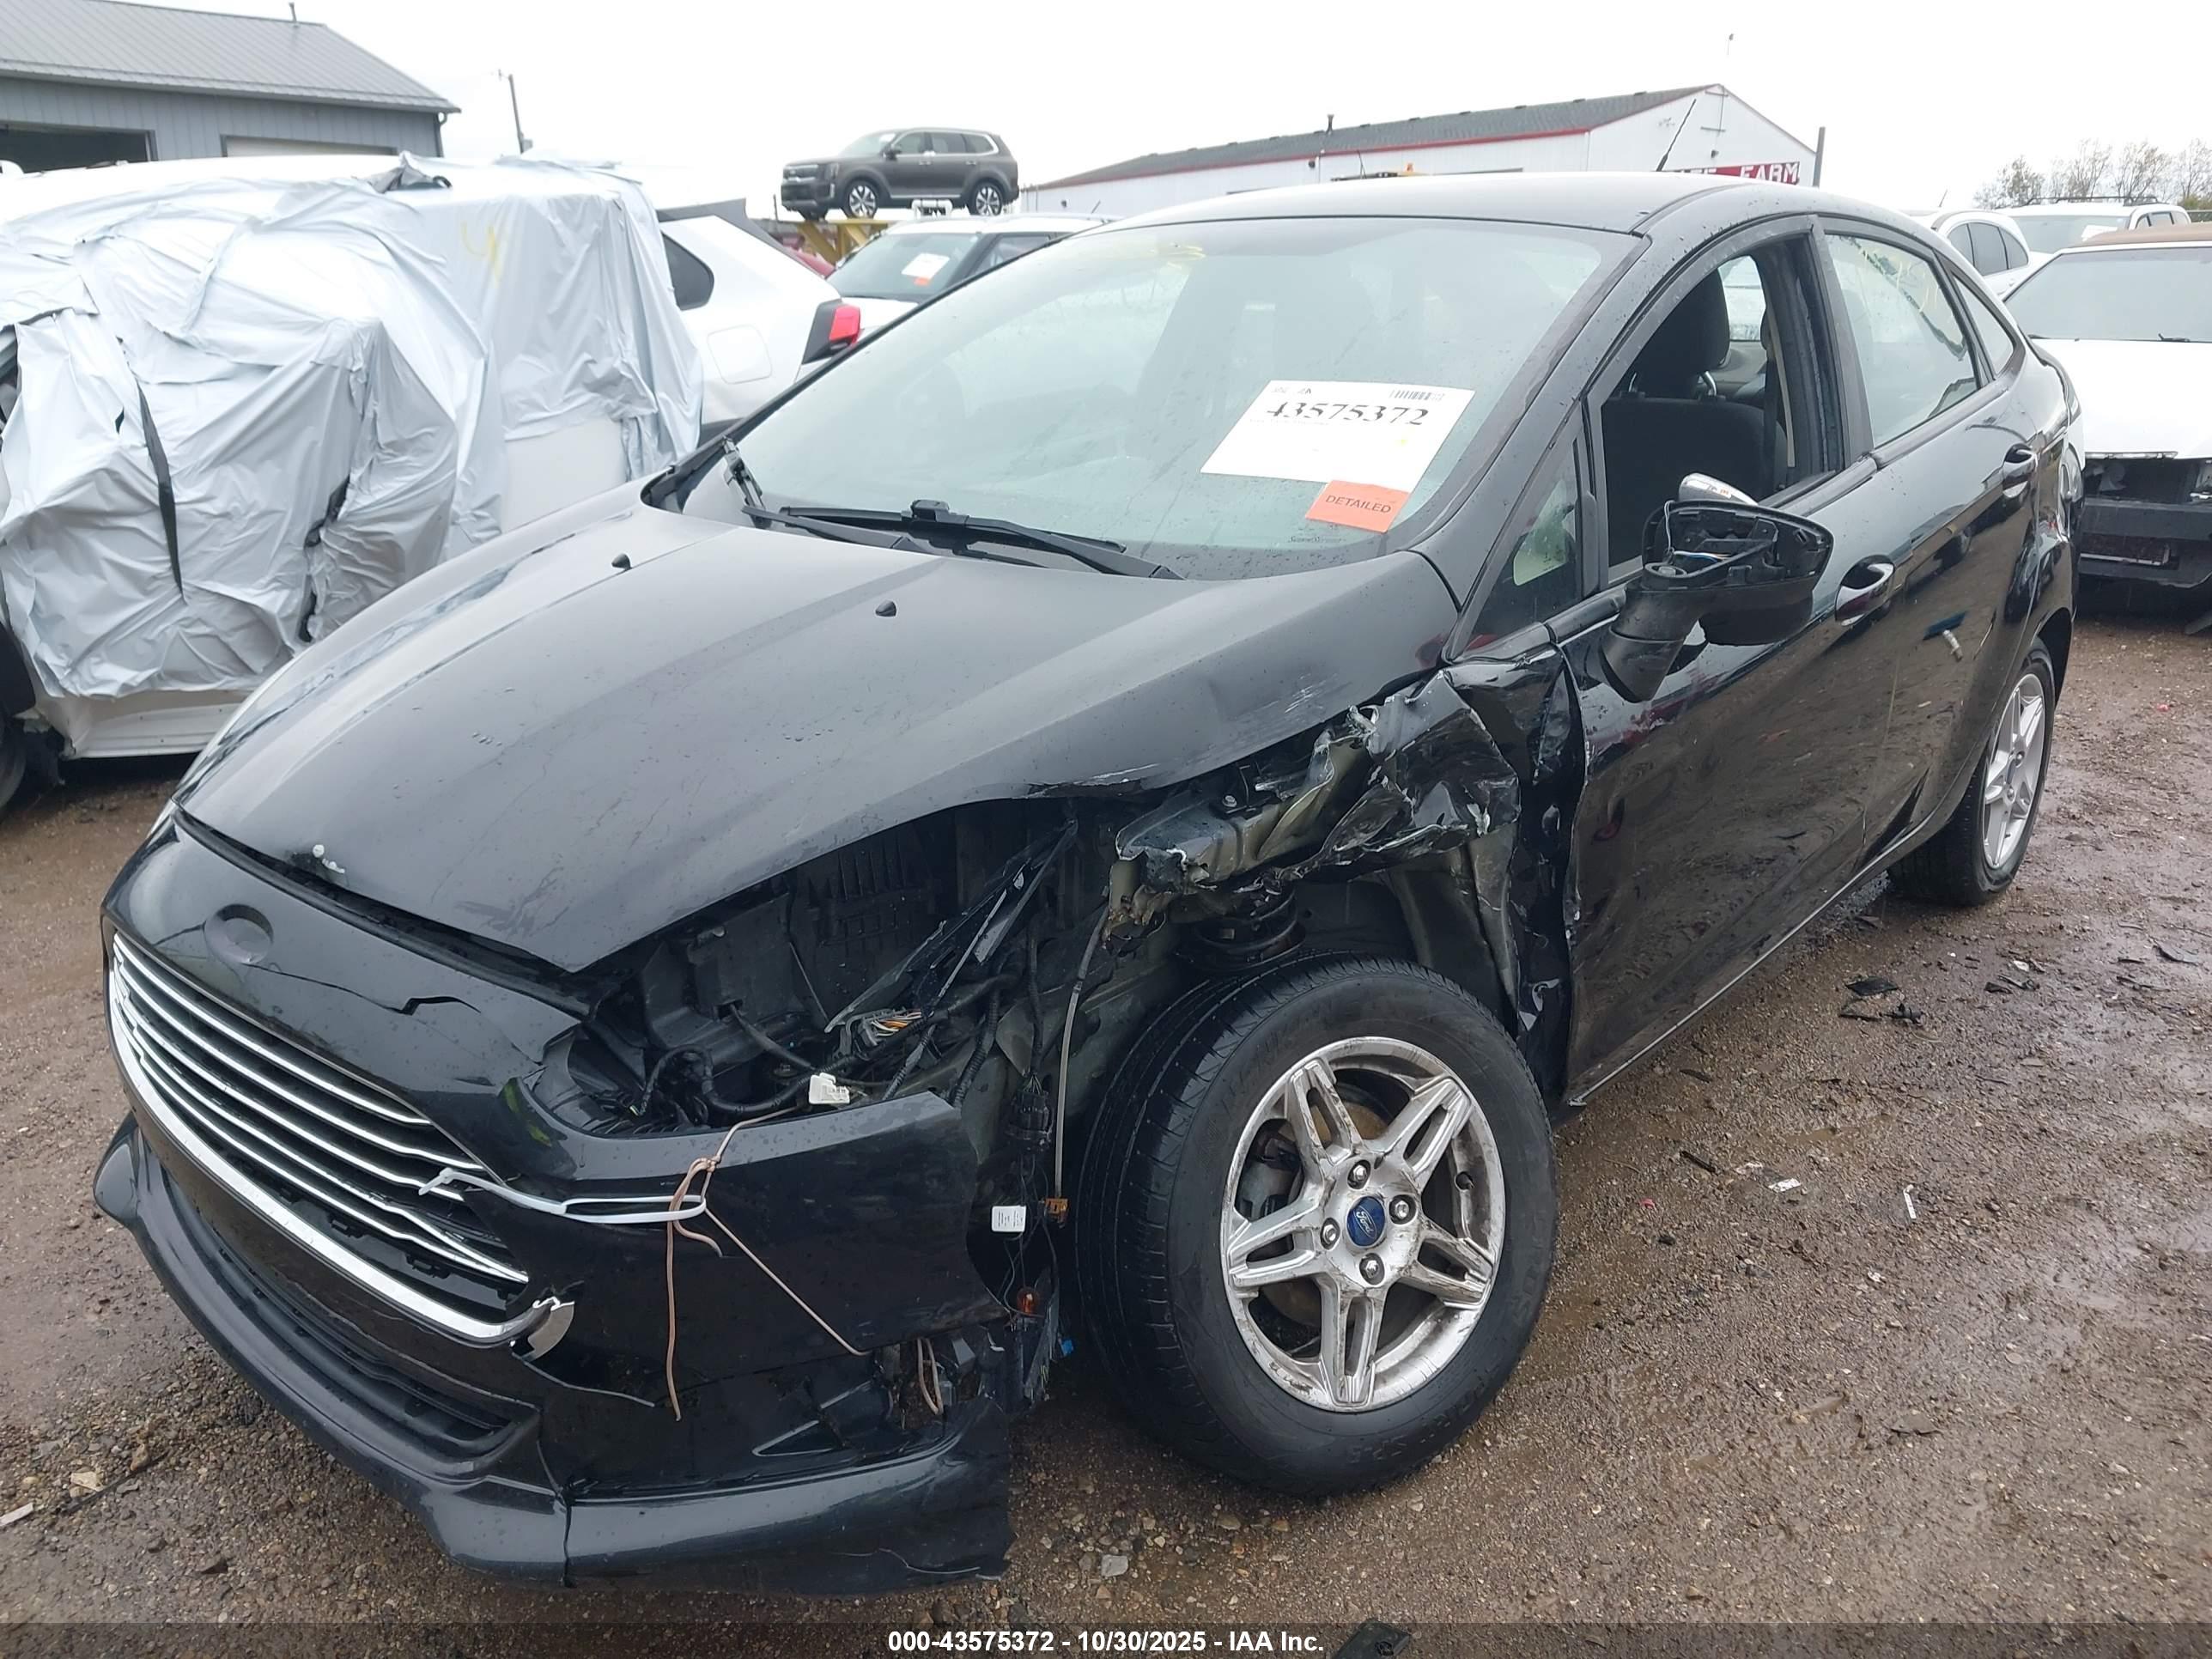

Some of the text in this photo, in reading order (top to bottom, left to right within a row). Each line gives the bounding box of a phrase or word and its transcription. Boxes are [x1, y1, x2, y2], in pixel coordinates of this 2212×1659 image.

[1741, 163, 1800, 183] FARM
[1267, 401, 1429, 426] 43575372
[1325, 494, 1392, 514] DETAILED
[1356, 1211, 1374, 1234] Ford
